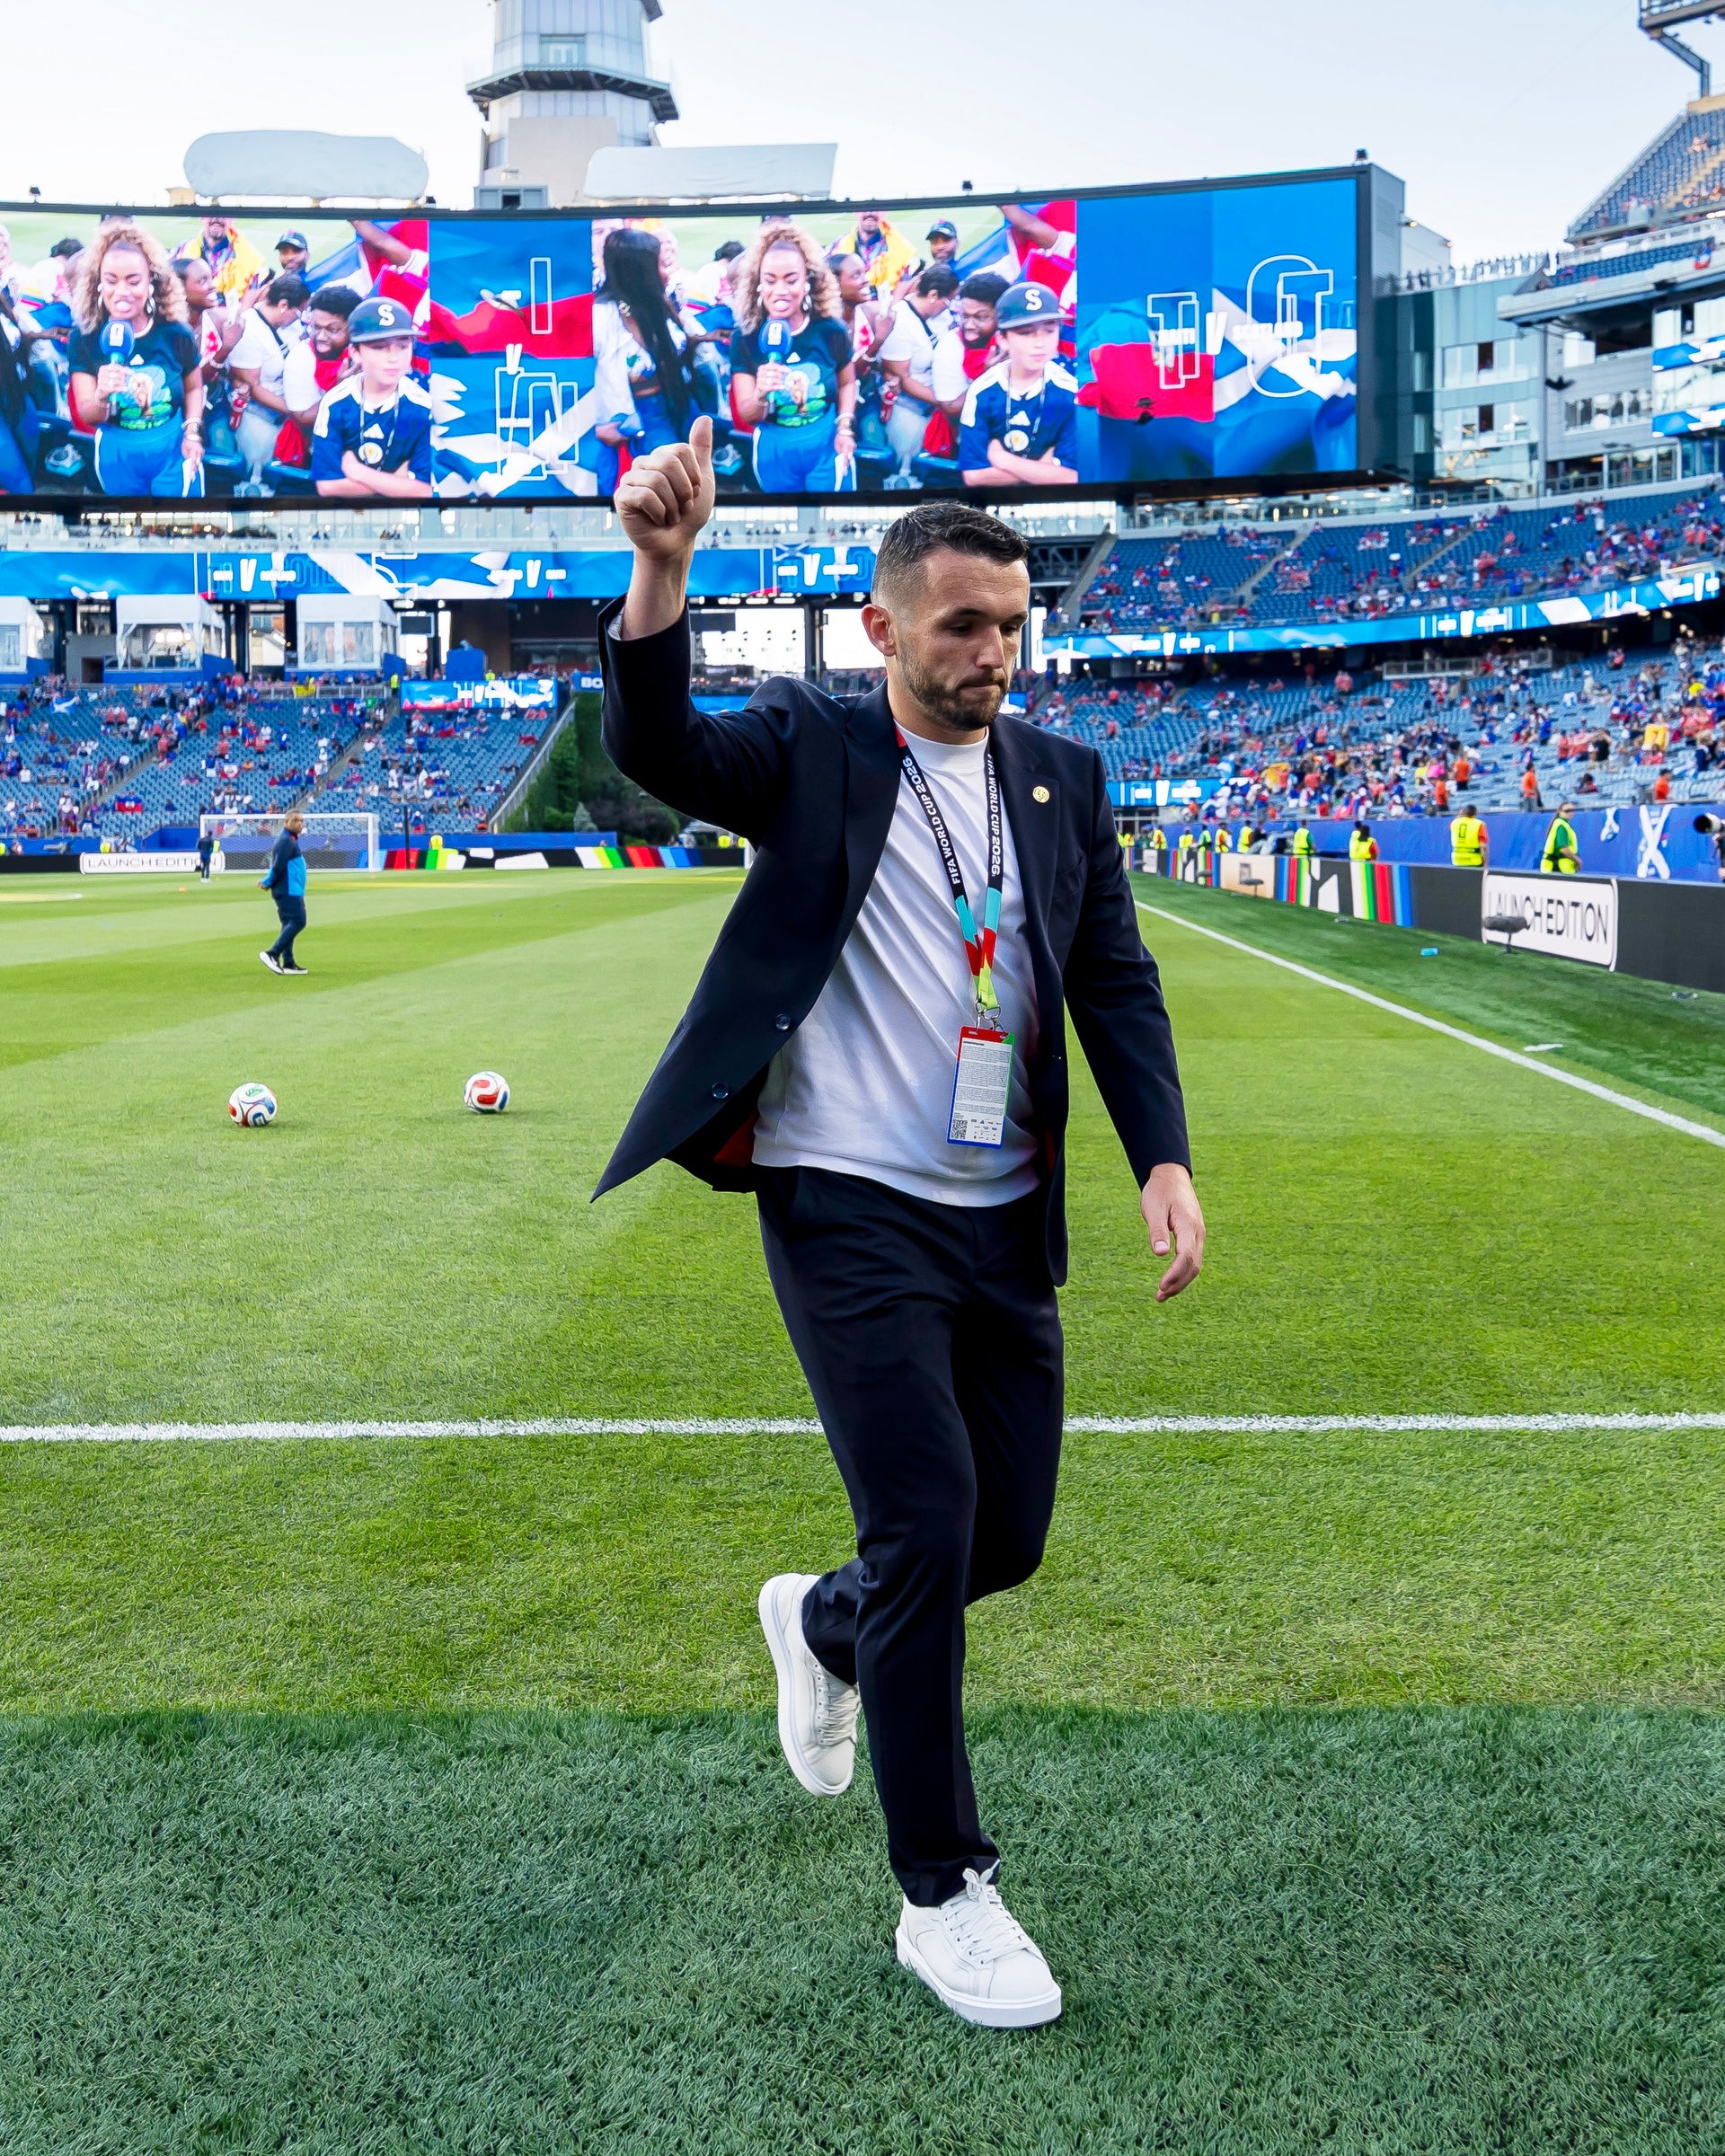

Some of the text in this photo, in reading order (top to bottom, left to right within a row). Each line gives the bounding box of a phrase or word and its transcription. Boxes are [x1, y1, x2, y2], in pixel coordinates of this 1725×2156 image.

[1024, 288, 1043, 312] S
[377, 304, 395, 327] S
[1206, 311, 1228, 355] V
[987, 754, 995, 775] FIFA
[920, 794, 937, 816] CUP
[989, 777, 998, 812] WORLD
[990, 813, 1000, 835] CUP
[931, 817, 953, 858] WORLD
[87, 858, 152, 869] LAUNCH
[946, 859, 960, 885] FIFA
[1545, 898, 1609, 944] EDITION
